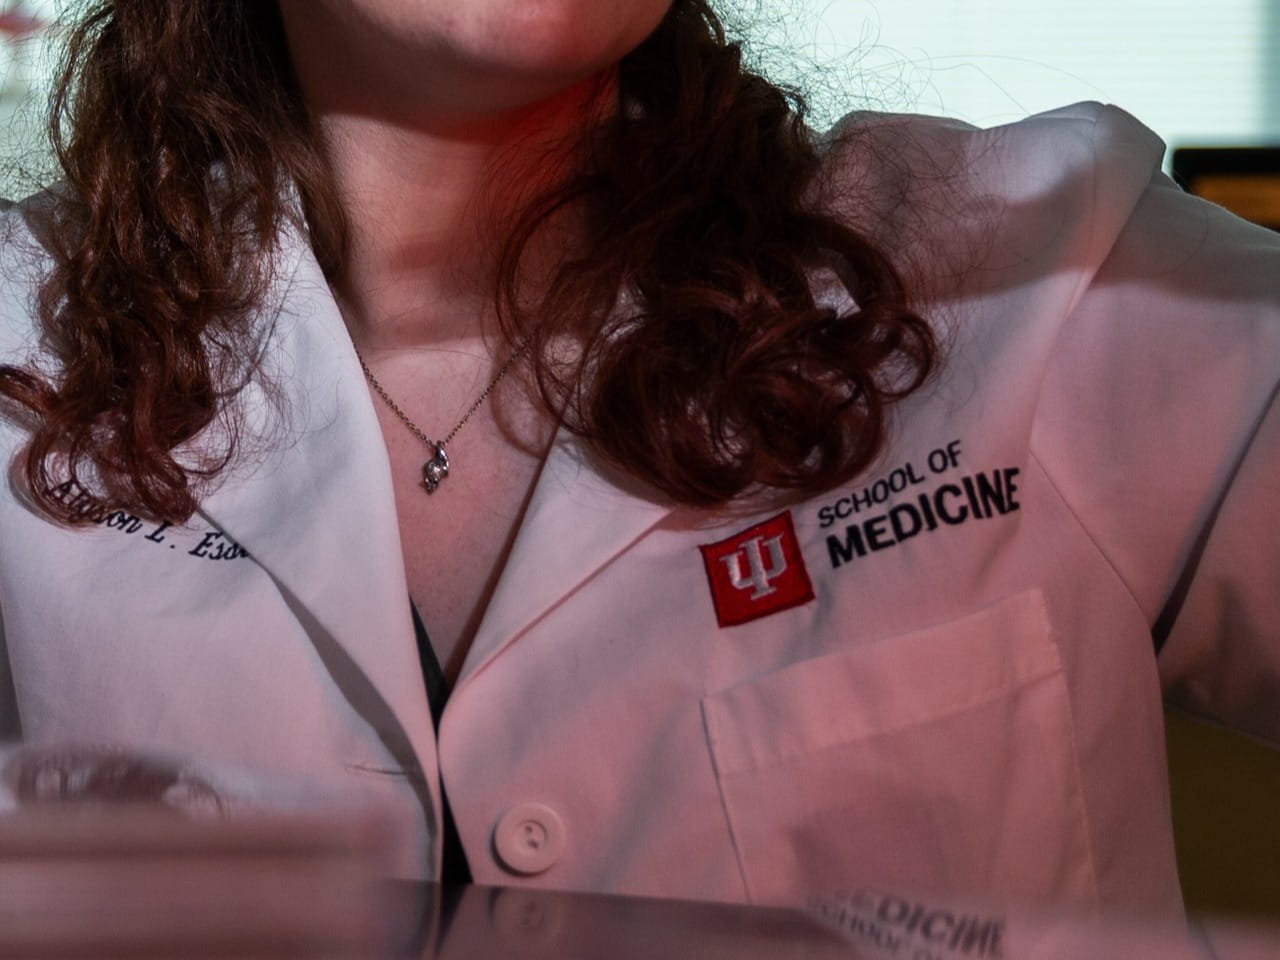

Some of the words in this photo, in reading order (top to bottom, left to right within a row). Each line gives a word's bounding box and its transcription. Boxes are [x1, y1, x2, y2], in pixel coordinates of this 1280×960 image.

[817, 462, 925, 529] SCHOOL
[927, 439, 962, 475] OF
[825, 467, 1020, 570] MEDICINE
